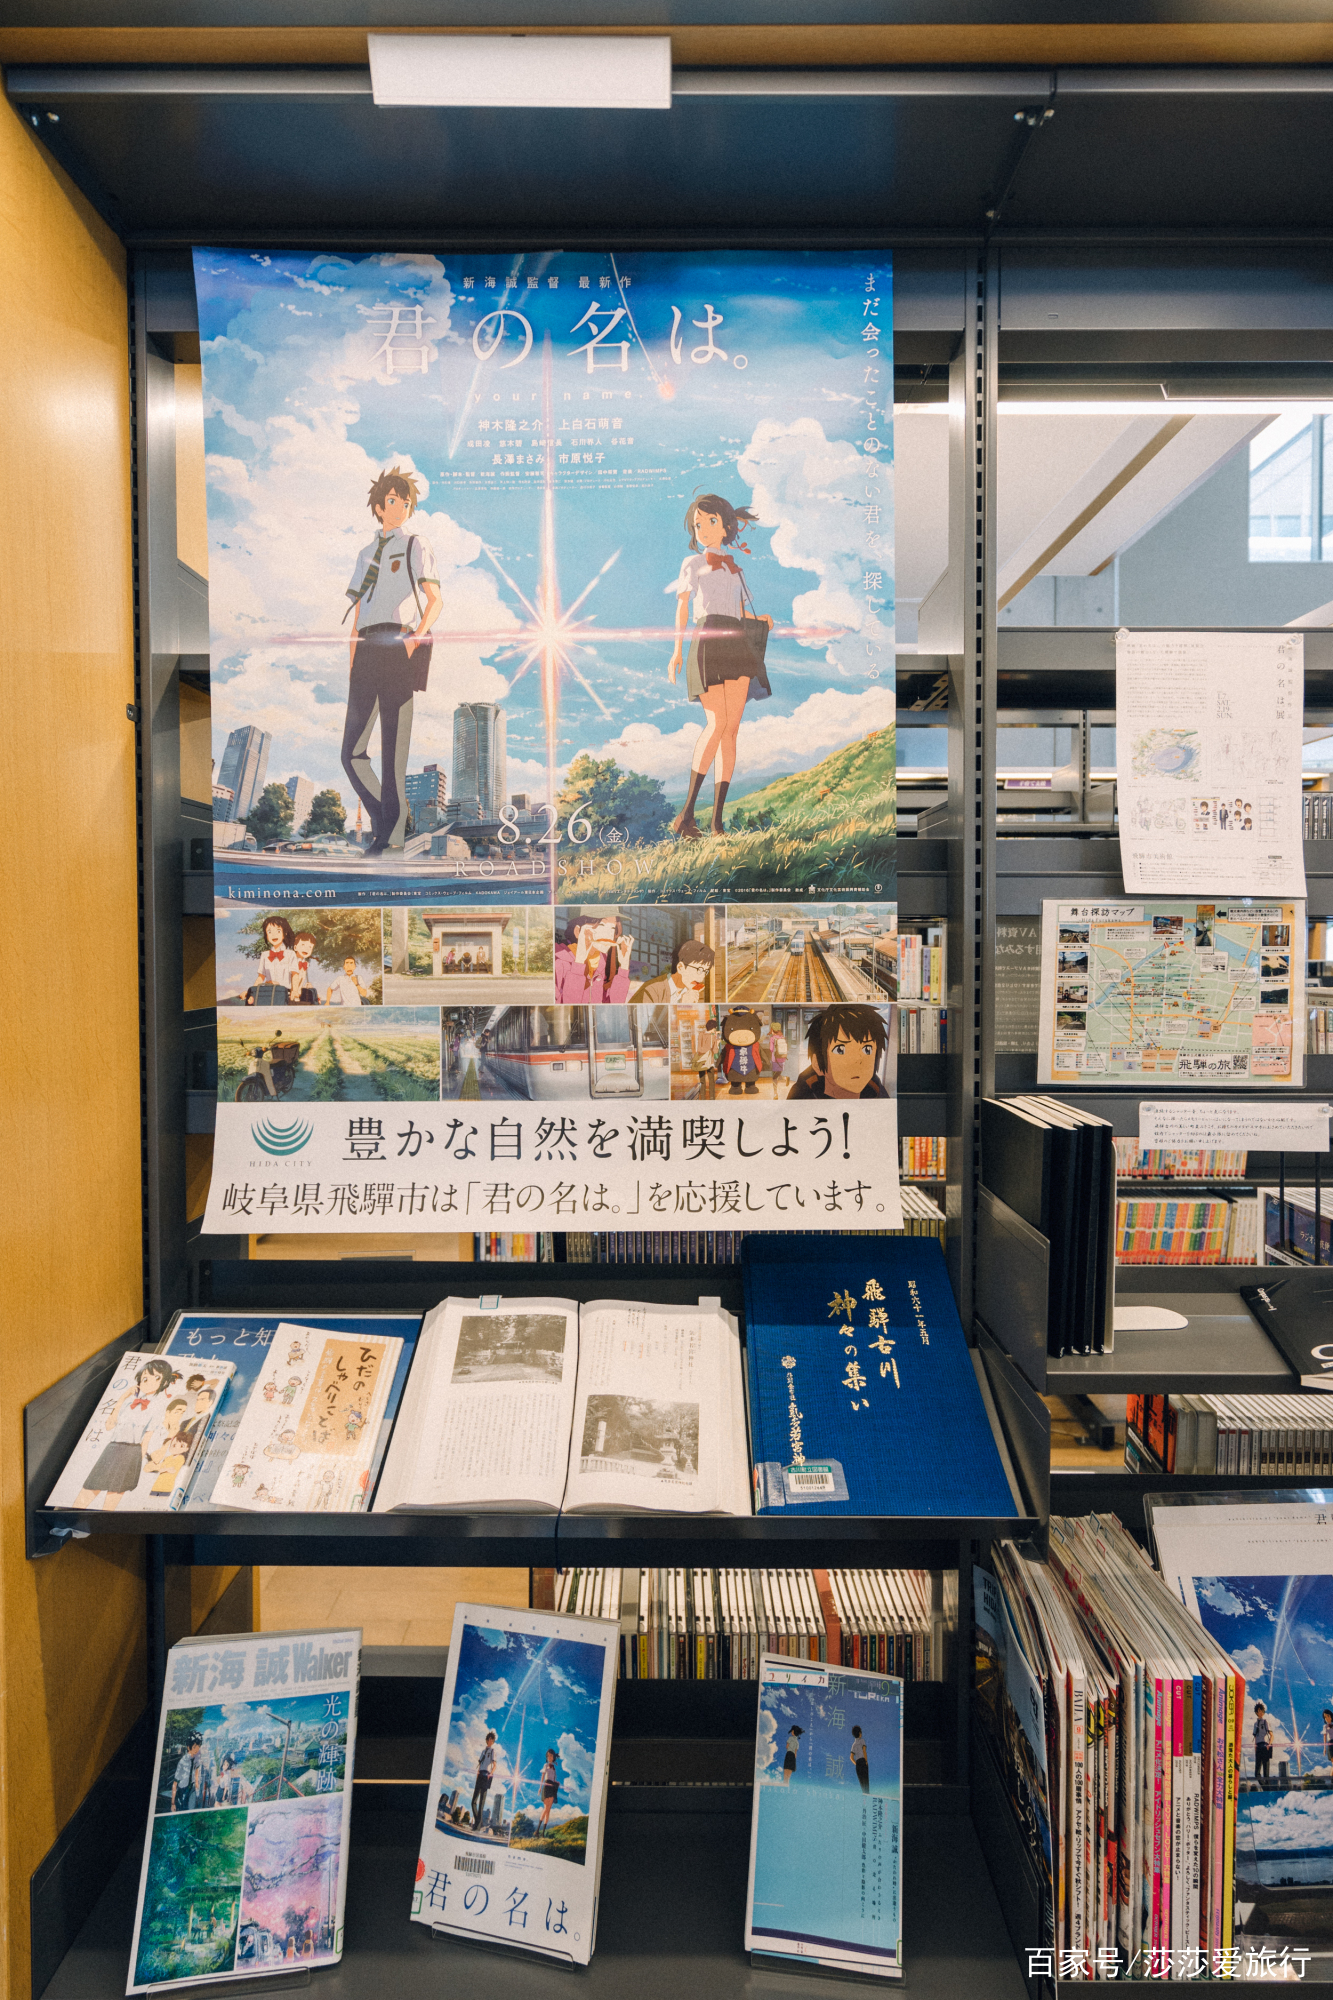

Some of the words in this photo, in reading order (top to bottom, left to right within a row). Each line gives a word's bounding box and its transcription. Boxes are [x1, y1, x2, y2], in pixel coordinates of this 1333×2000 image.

[463, 276, 560, 289] 新海誠監督
[579, 276, 632, 289] 最新作
[366, 301, 749, 375] 君の名は。
[474, 392, 537, 403] your
[478, 418, 544, 432] 神木隆之介
[558, 417, 624, 431] 上白石萌音
[559, 452, 606, 465] 市原悦子
[861, 273, 882, 680] まだ会ったことのない君を、探している
[498, 801, 593, 845] 8.26
[454, 859, 655, 877] ROADSHOW
[228, 886, 337, 899] kiminona.com
[1070, 907, 1135, 917] 舞台探訪マップ
[907, 1280, 931, 1346] 昭和六十一年五月
[352, 1346, 377, 1391] ひだの
[827, 1289, 871, 1412] 神々の集い
[85, 1355, 142, 1449] 君の名は。
[318, 1356, 349, 1445] しゃべりことば
[768, 1672, 826, 1685] ユリイカ
[1073, 1690, 1084, 1722] BAILA
[1216, 1687, 1225, 1725] Animage
[315, 1694, 342, 1793] 光の輝跡
[425, 1868, 581, 1942] 君の名は。
